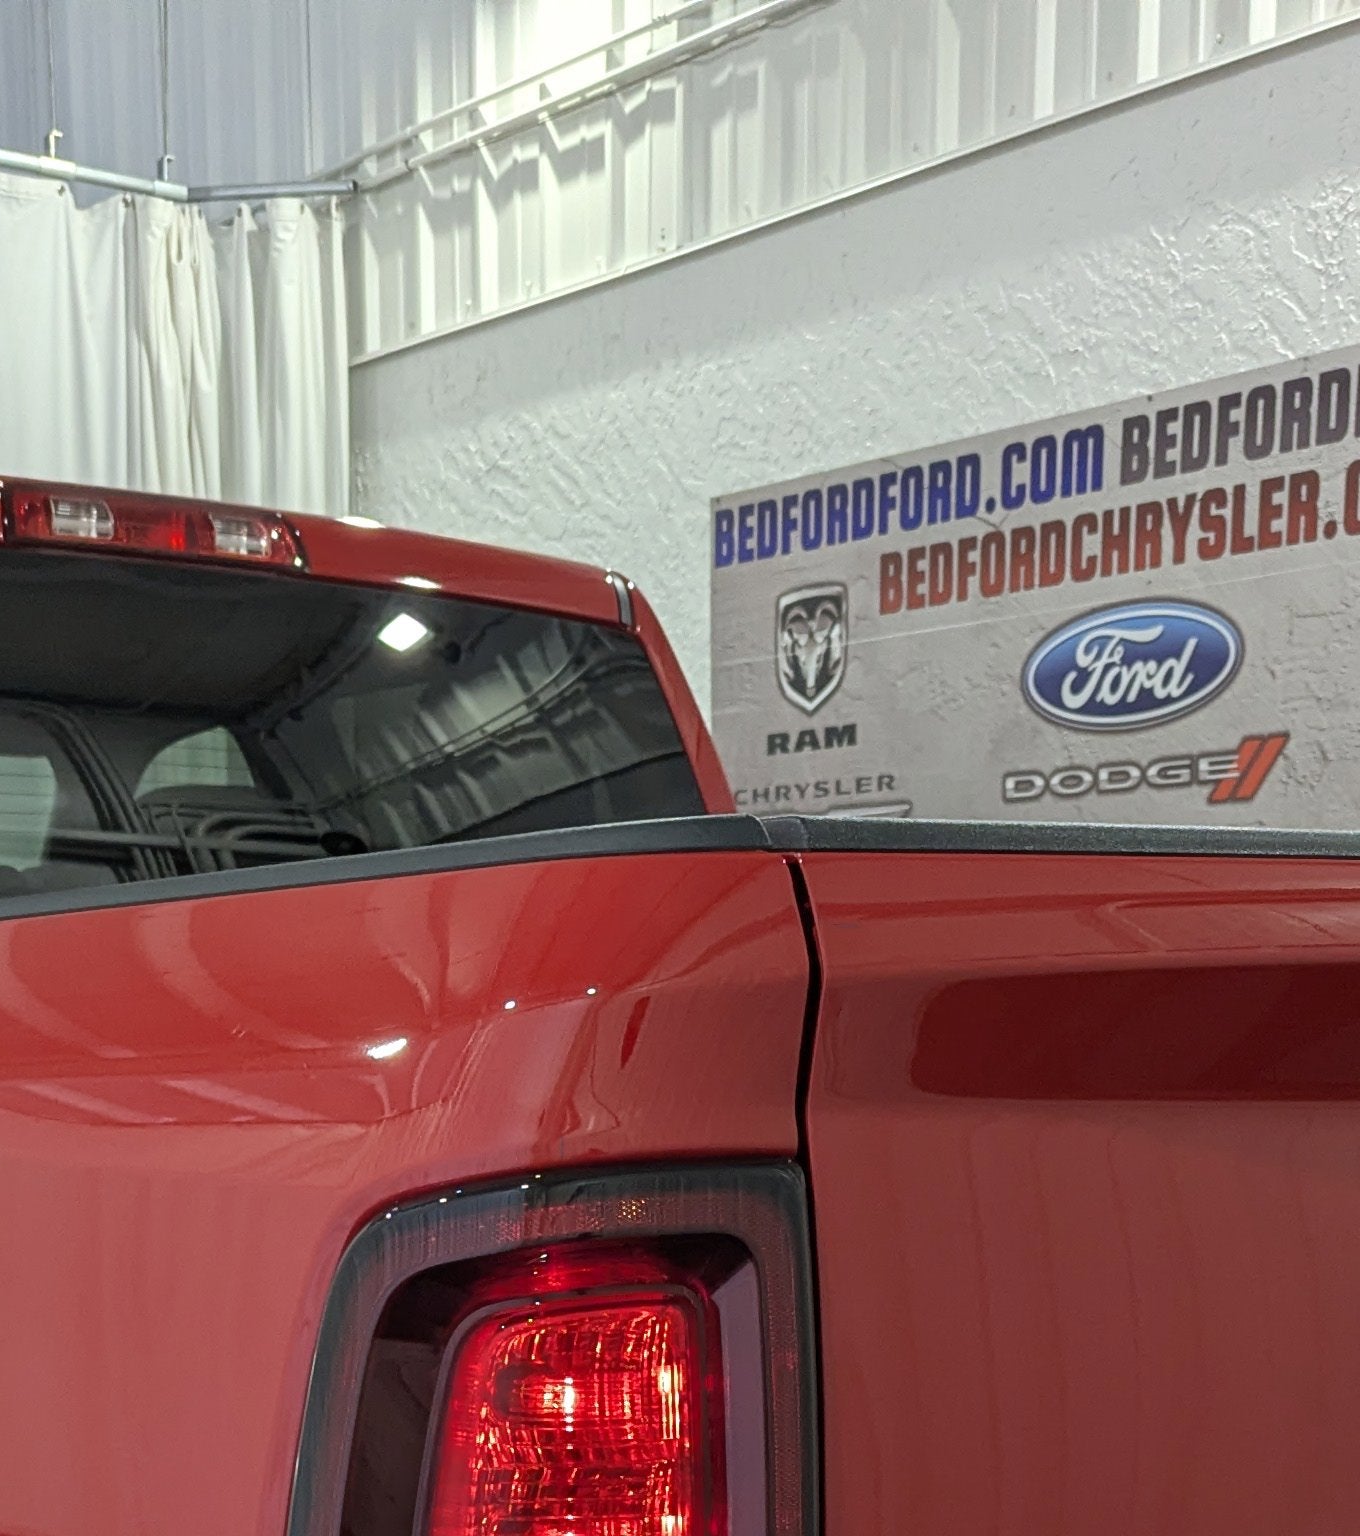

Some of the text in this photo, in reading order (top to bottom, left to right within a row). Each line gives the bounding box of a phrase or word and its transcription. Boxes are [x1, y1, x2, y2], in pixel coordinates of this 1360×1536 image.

[715, 424, 1104, 568] BEDFORDFORD.COM
[1061, 625, 1198, 709] Ford
[767, 724, 857, 756] RAM
[734, 775, 895, 806] CHRYSLER
[1002, 750, 1241, 803] DODGE
